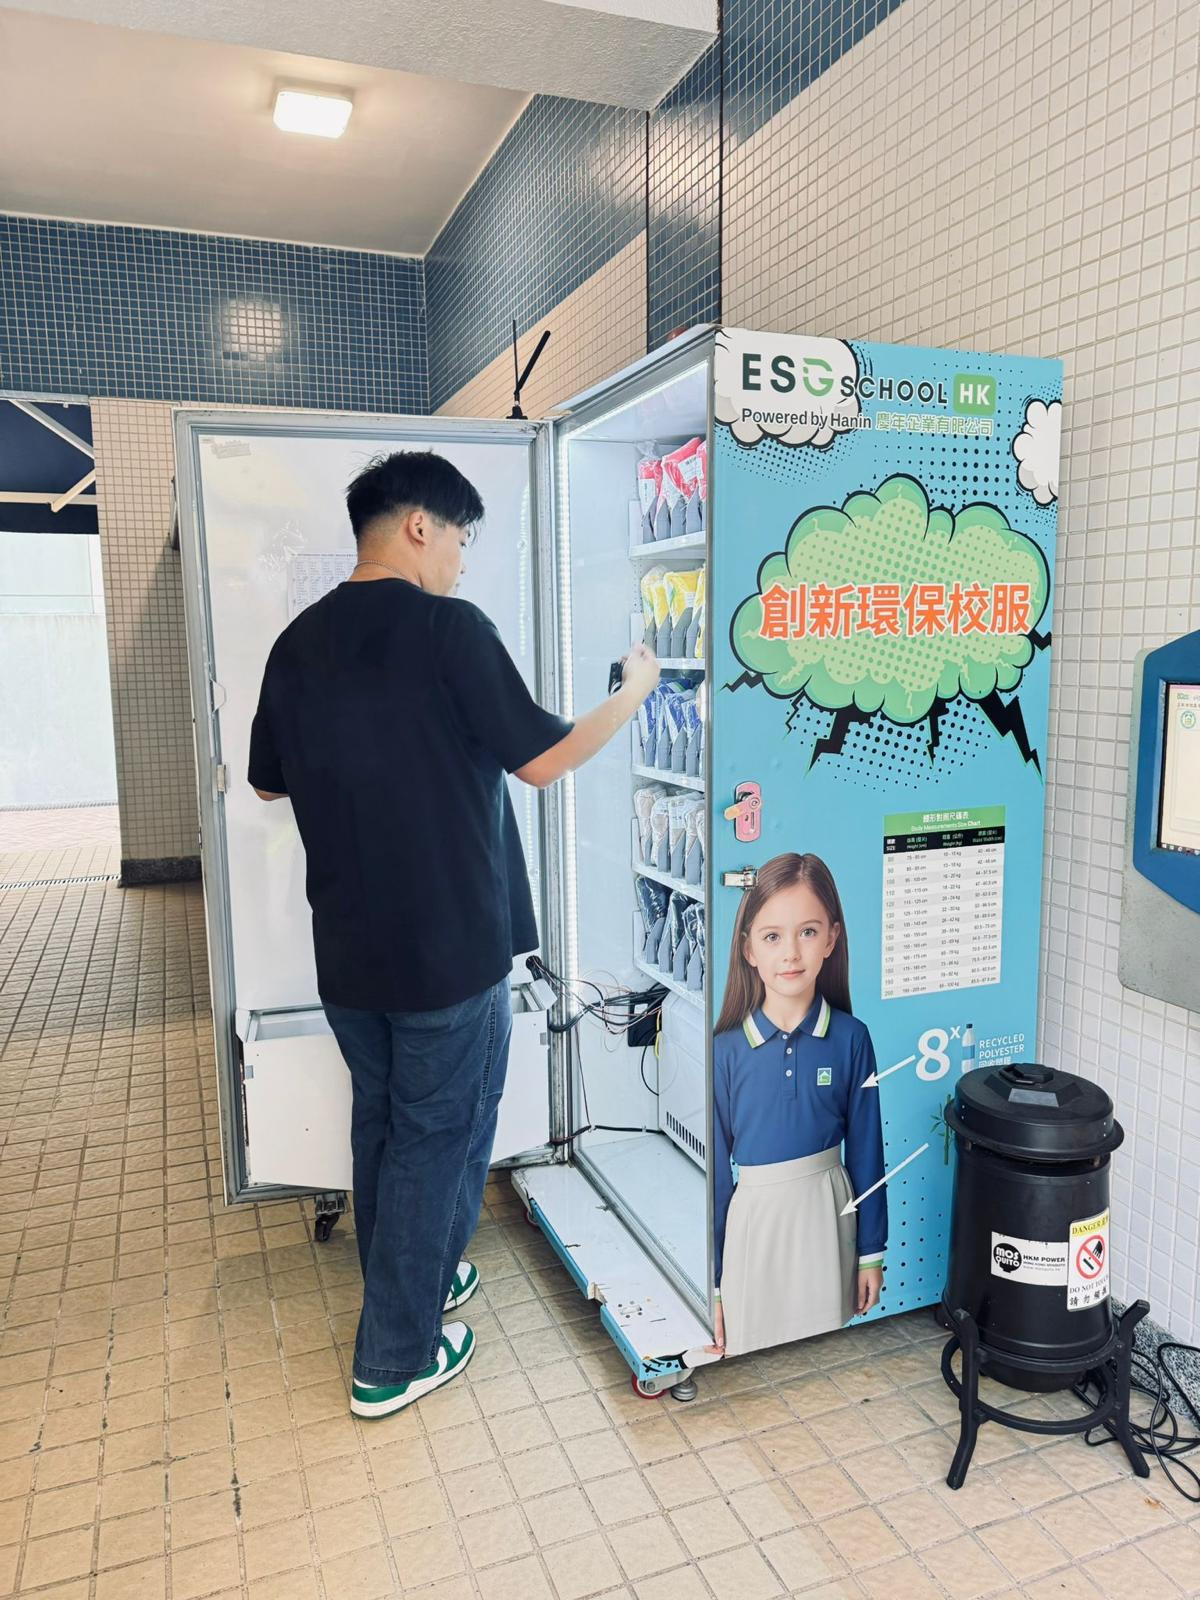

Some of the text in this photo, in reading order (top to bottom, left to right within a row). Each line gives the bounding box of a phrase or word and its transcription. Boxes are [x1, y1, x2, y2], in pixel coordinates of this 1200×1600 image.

[742, 352, 991, 406] ESG SCHOOL HK
[742, 408, 872, 430] Powered by Hanin
[758, 582, 1032, 640] 創新環保校服
[979, 1033, 1025, 1049] RECYCLED
[916, 1028, 950, 1081] 8
[979, 1043, 1025, 1060] POLYESTER
[1072, 1220, 1102, 1235] DANGER
[995, 1255, 1020, 1268] QUITO
[1069, 1286, 1080, 1294] DO
[1082, 1282, 1094, 1292] NOT
